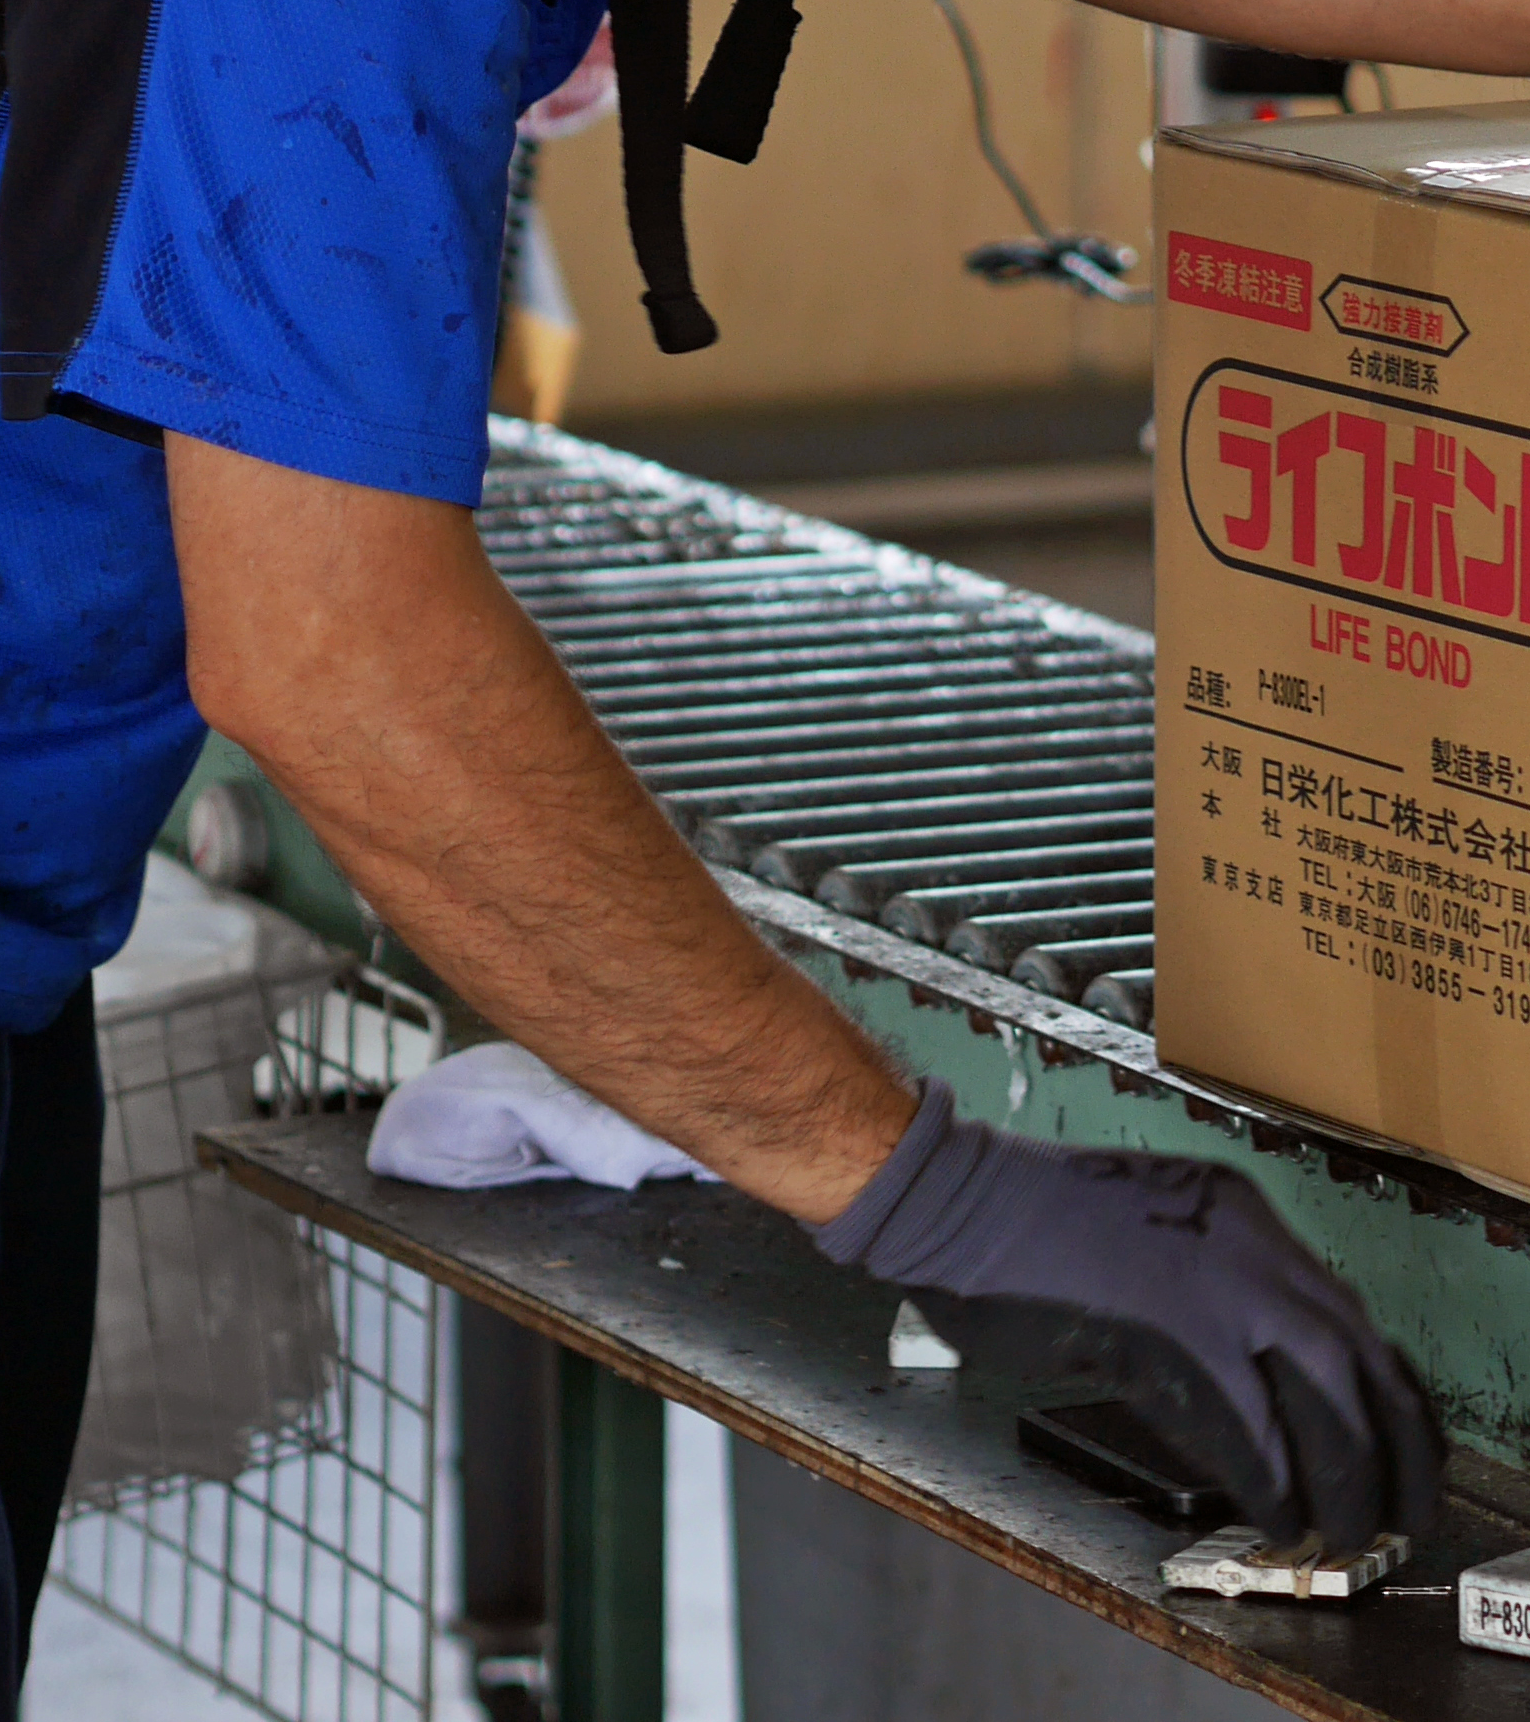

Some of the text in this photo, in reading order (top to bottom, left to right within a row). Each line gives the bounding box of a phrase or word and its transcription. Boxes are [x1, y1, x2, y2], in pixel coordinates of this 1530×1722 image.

[1175, 248, 1304, 314] 冬季凍結注意
[1341, 292, 1445, 345] 強力接着剤
[1346, 346, 1439, 395] 合成樹脂系
[1309, 603, 1471, 690] LIFE BOND
[1200, 740, 1243, 778] 大阪
[1200, 854, 1285, 908] 東京支店
